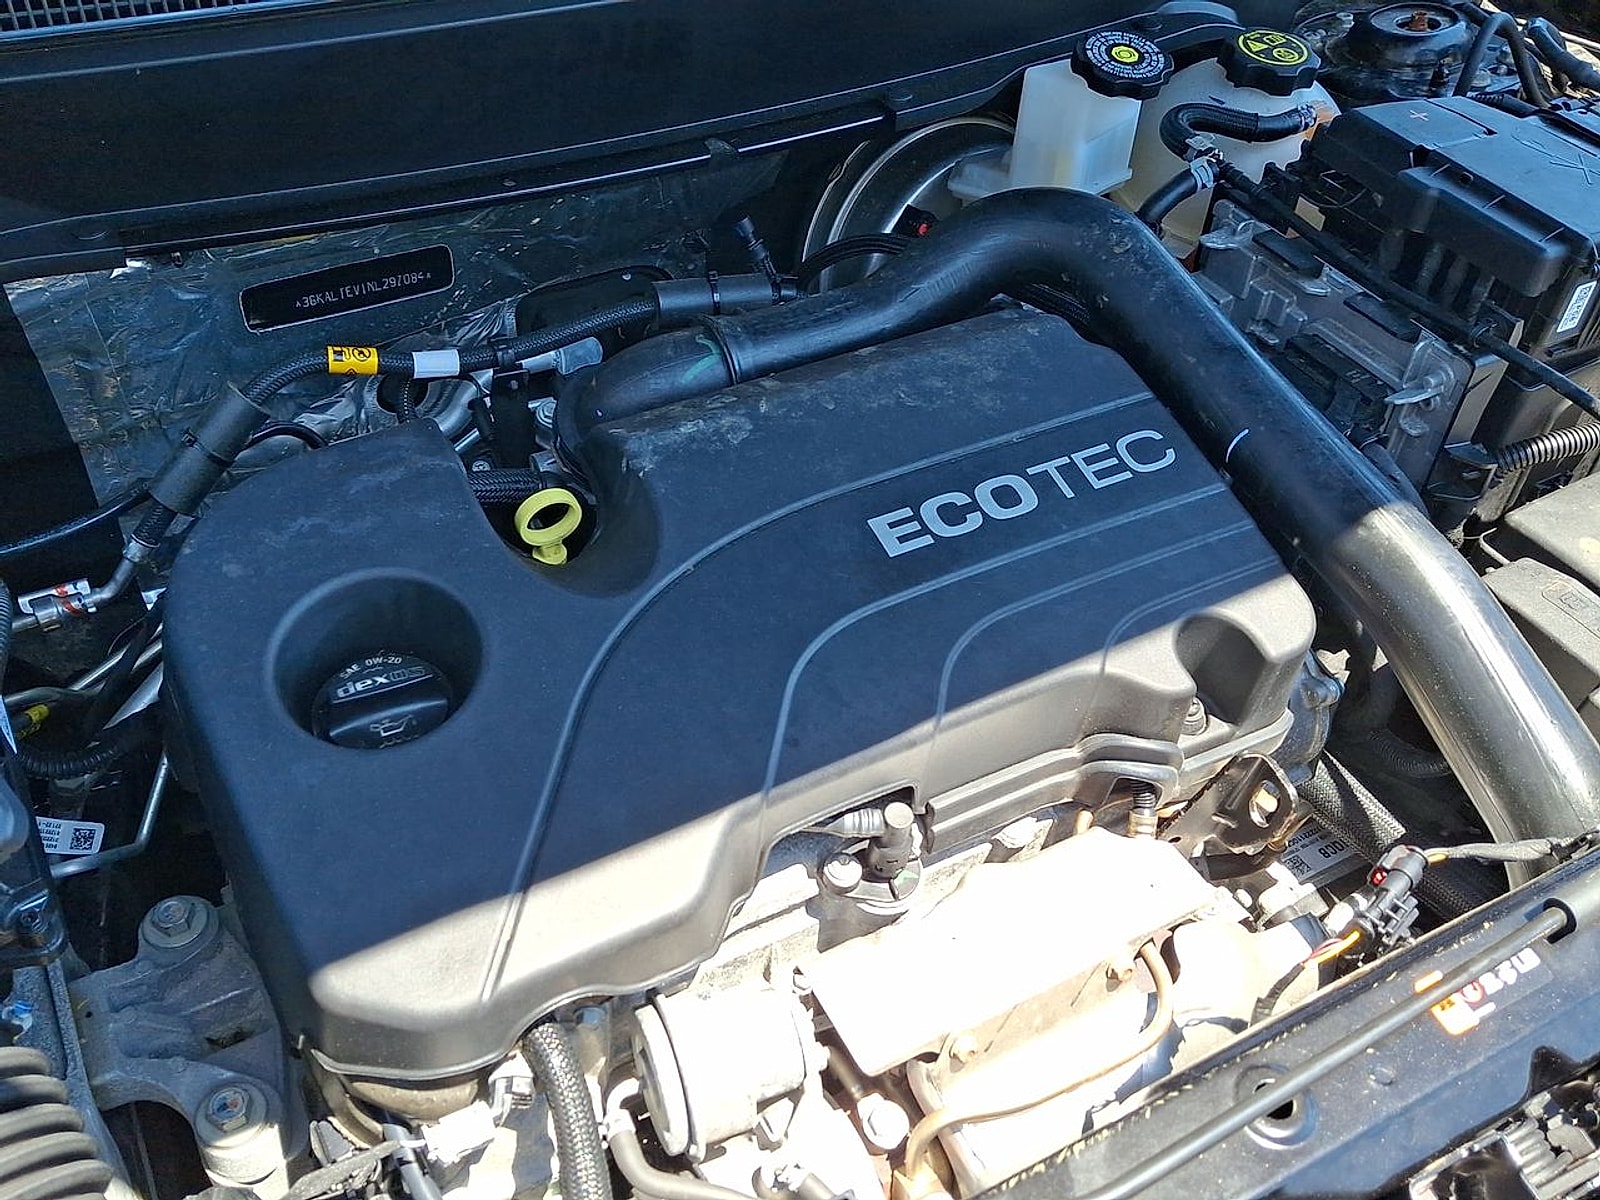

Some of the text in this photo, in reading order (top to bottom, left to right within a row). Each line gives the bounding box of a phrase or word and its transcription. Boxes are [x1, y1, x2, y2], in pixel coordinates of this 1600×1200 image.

[867, 430, 1176, 558] ECOTEC
[336, 666, 425, 698] dexos
[340, 656, 403, 680] SAE 0W-20
